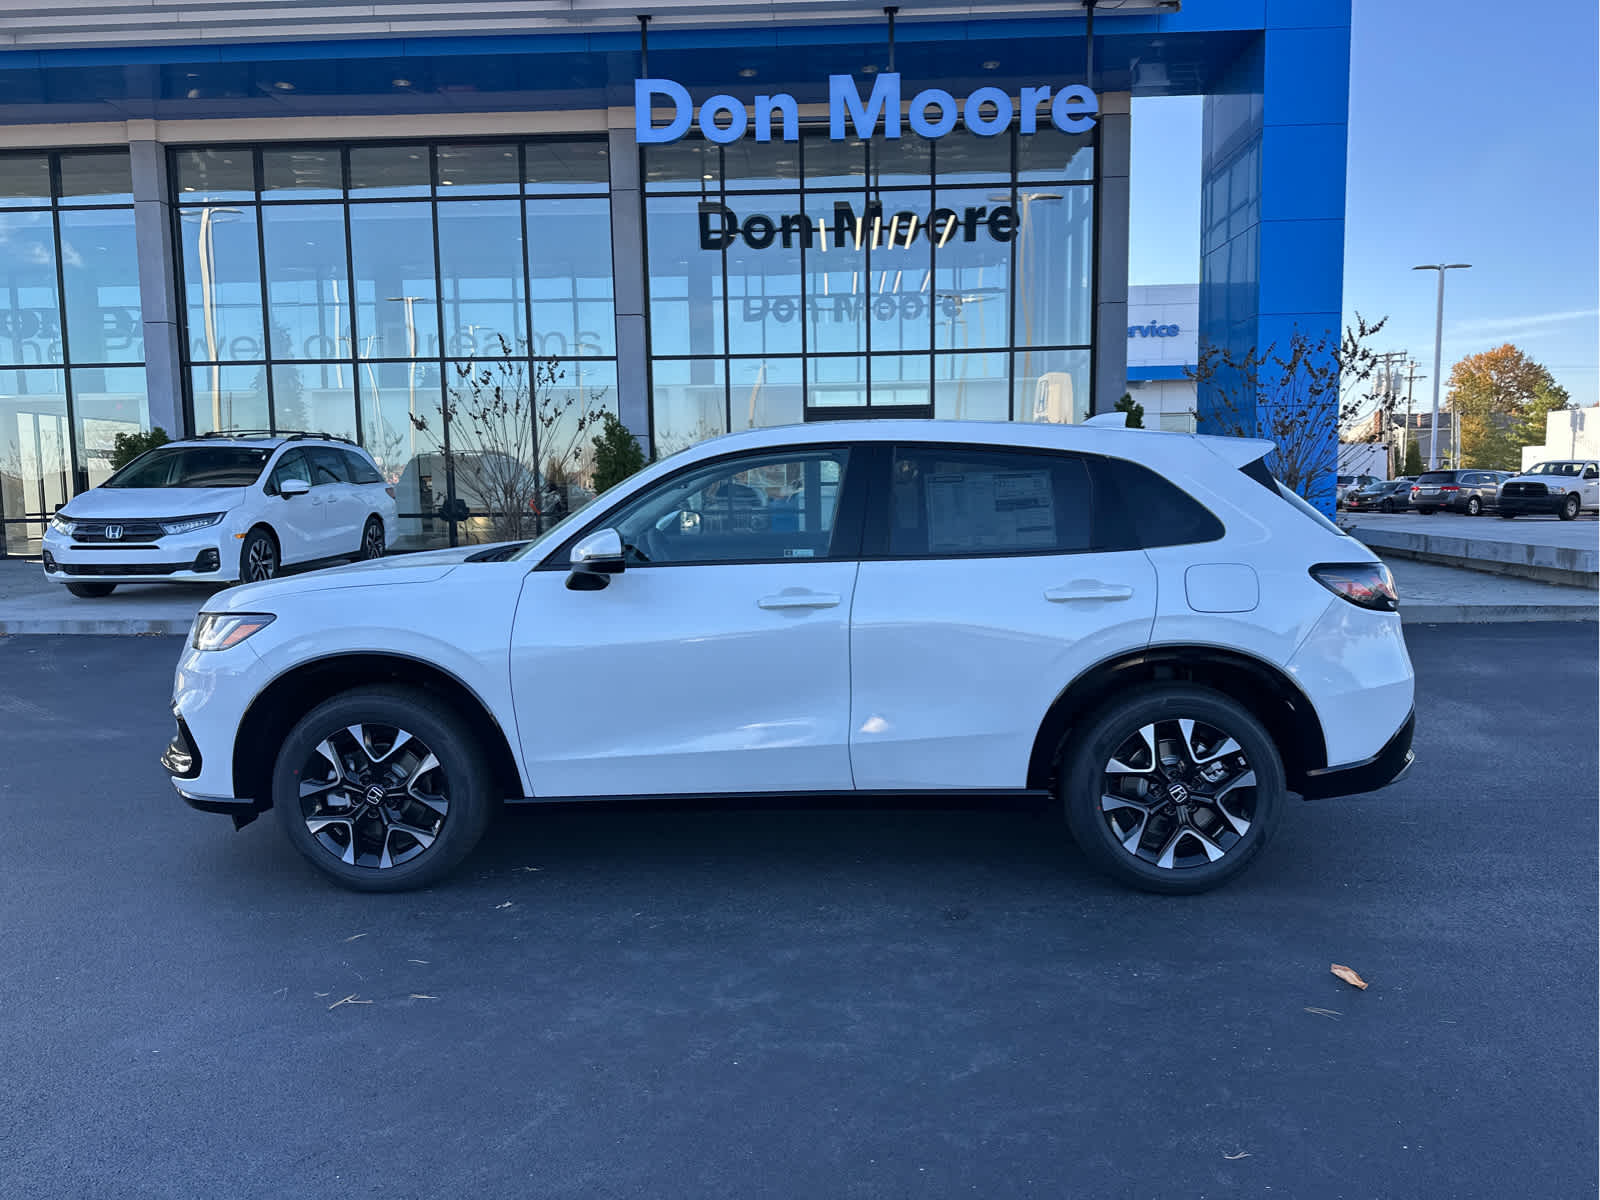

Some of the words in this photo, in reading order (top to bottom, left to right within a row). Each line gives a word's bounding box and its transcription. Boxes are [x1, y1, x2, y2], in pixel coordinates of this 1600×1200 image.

[635, 78, 798, 145] Don
[828, 72, 1099, 143] Moore
[698, 201, 813, 250] Don
[834, 201, 1020, 248] Moore
[833, 294, 961, 322] Mooe
[1127, 319, 1180, 338] rvice
